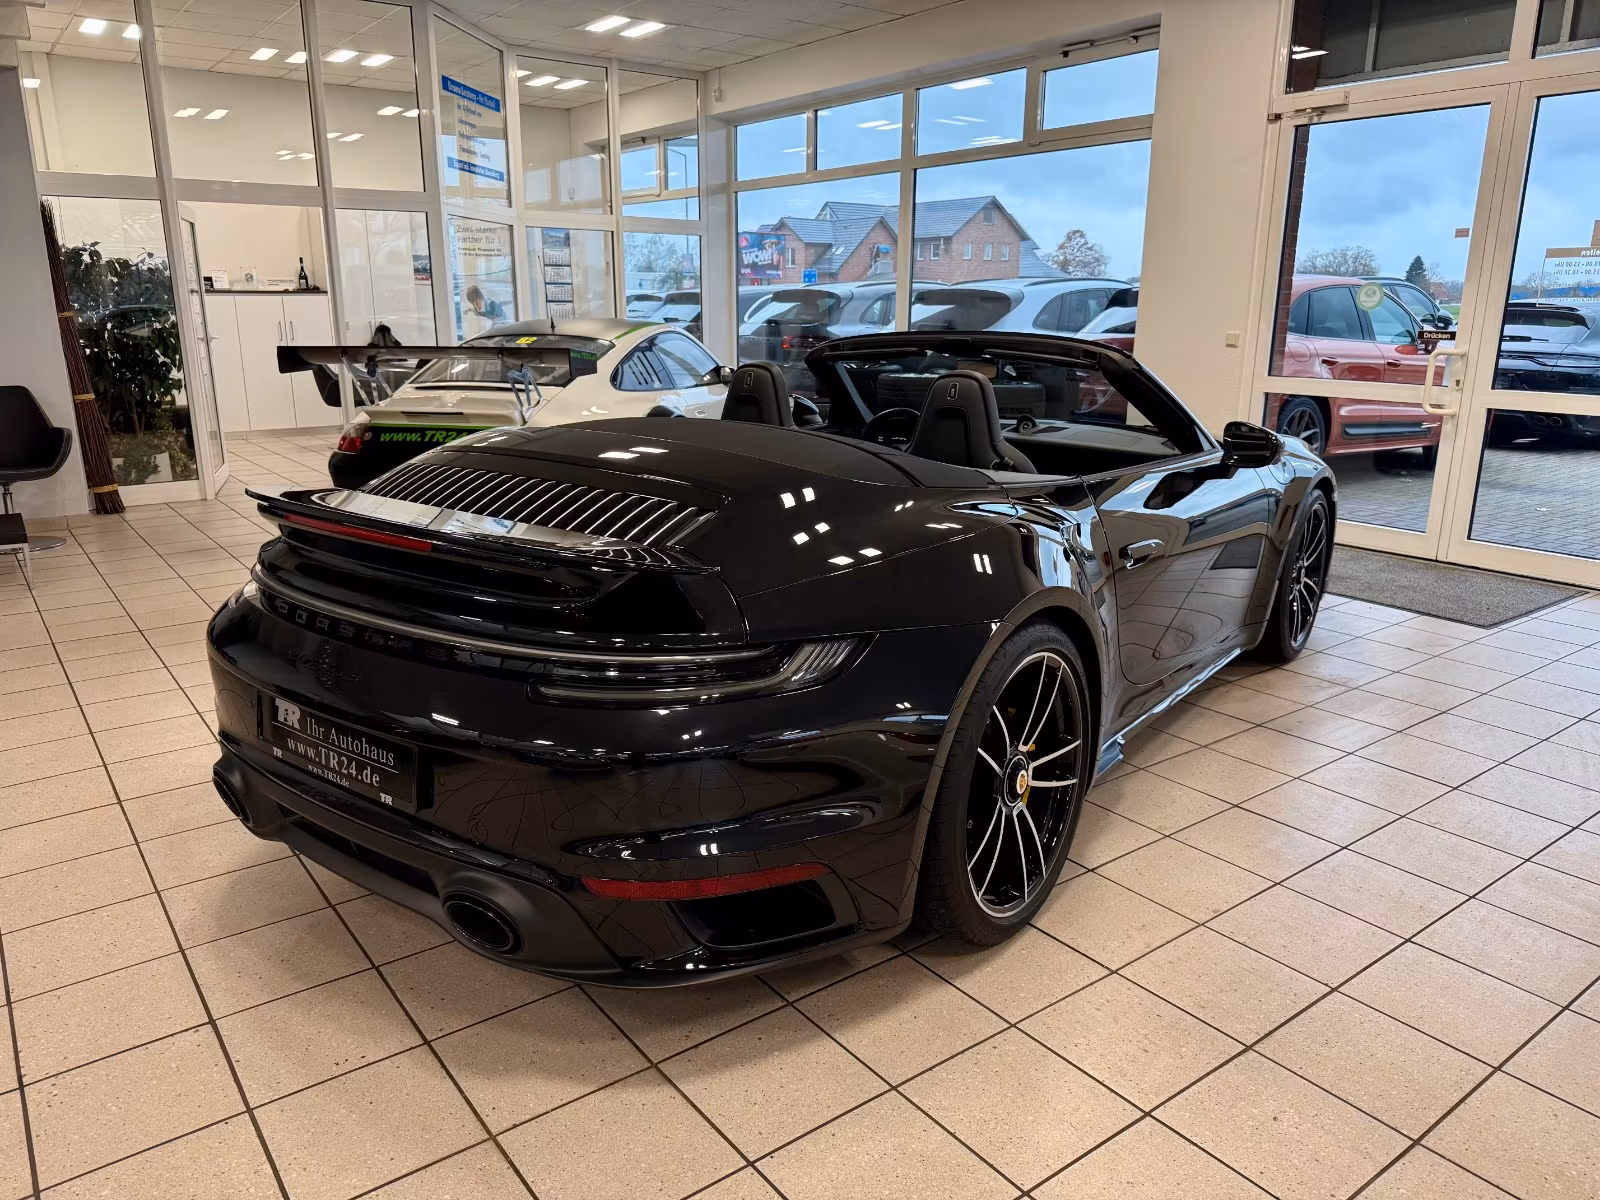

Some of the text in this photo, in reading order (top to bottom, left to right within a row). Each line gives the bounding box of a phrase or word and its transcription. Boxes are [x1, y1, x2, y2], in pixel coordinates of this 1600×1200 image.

[456, 224, 497, 234] Zwei starke
[457, 235, 482, 243] Partner
[485, 236, 495, 244] für
[286, 737, 380, 787] www.TR24.de
[306, 716, 325, 739] Ihr
[329, 727, 394, 766] Autohaus
[308, 763, 350, 788] www.TR24.de
[380, 792, 393, 806] TR
